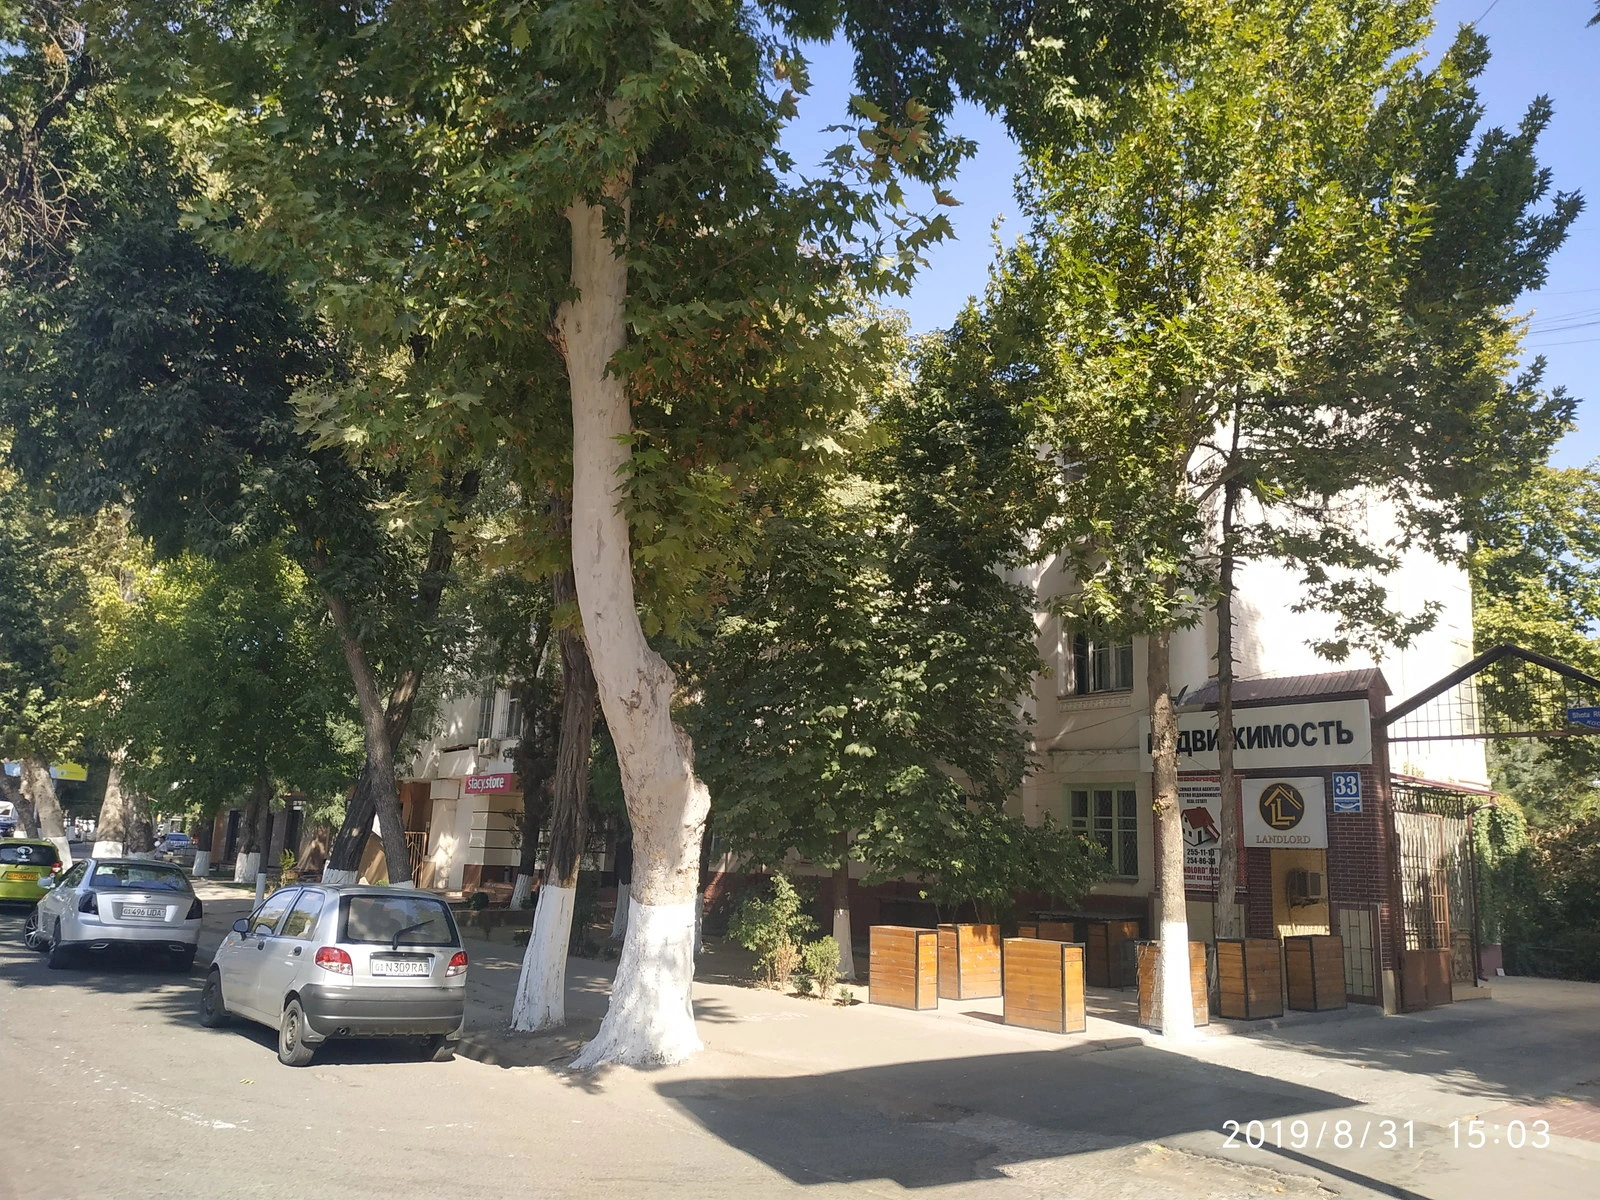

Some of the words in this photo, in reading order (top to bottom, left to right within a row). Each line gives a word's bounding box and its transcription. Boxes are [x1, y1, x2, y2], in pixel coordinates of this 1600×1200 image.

[1148, 720, 1354, 756] ДВИЖИМОСТЬ
[468, 777, 505, 792] stacy.store
[1335, 775, 1357, 795] 33
[1256, 834, 1311, 844] LANDLORD
